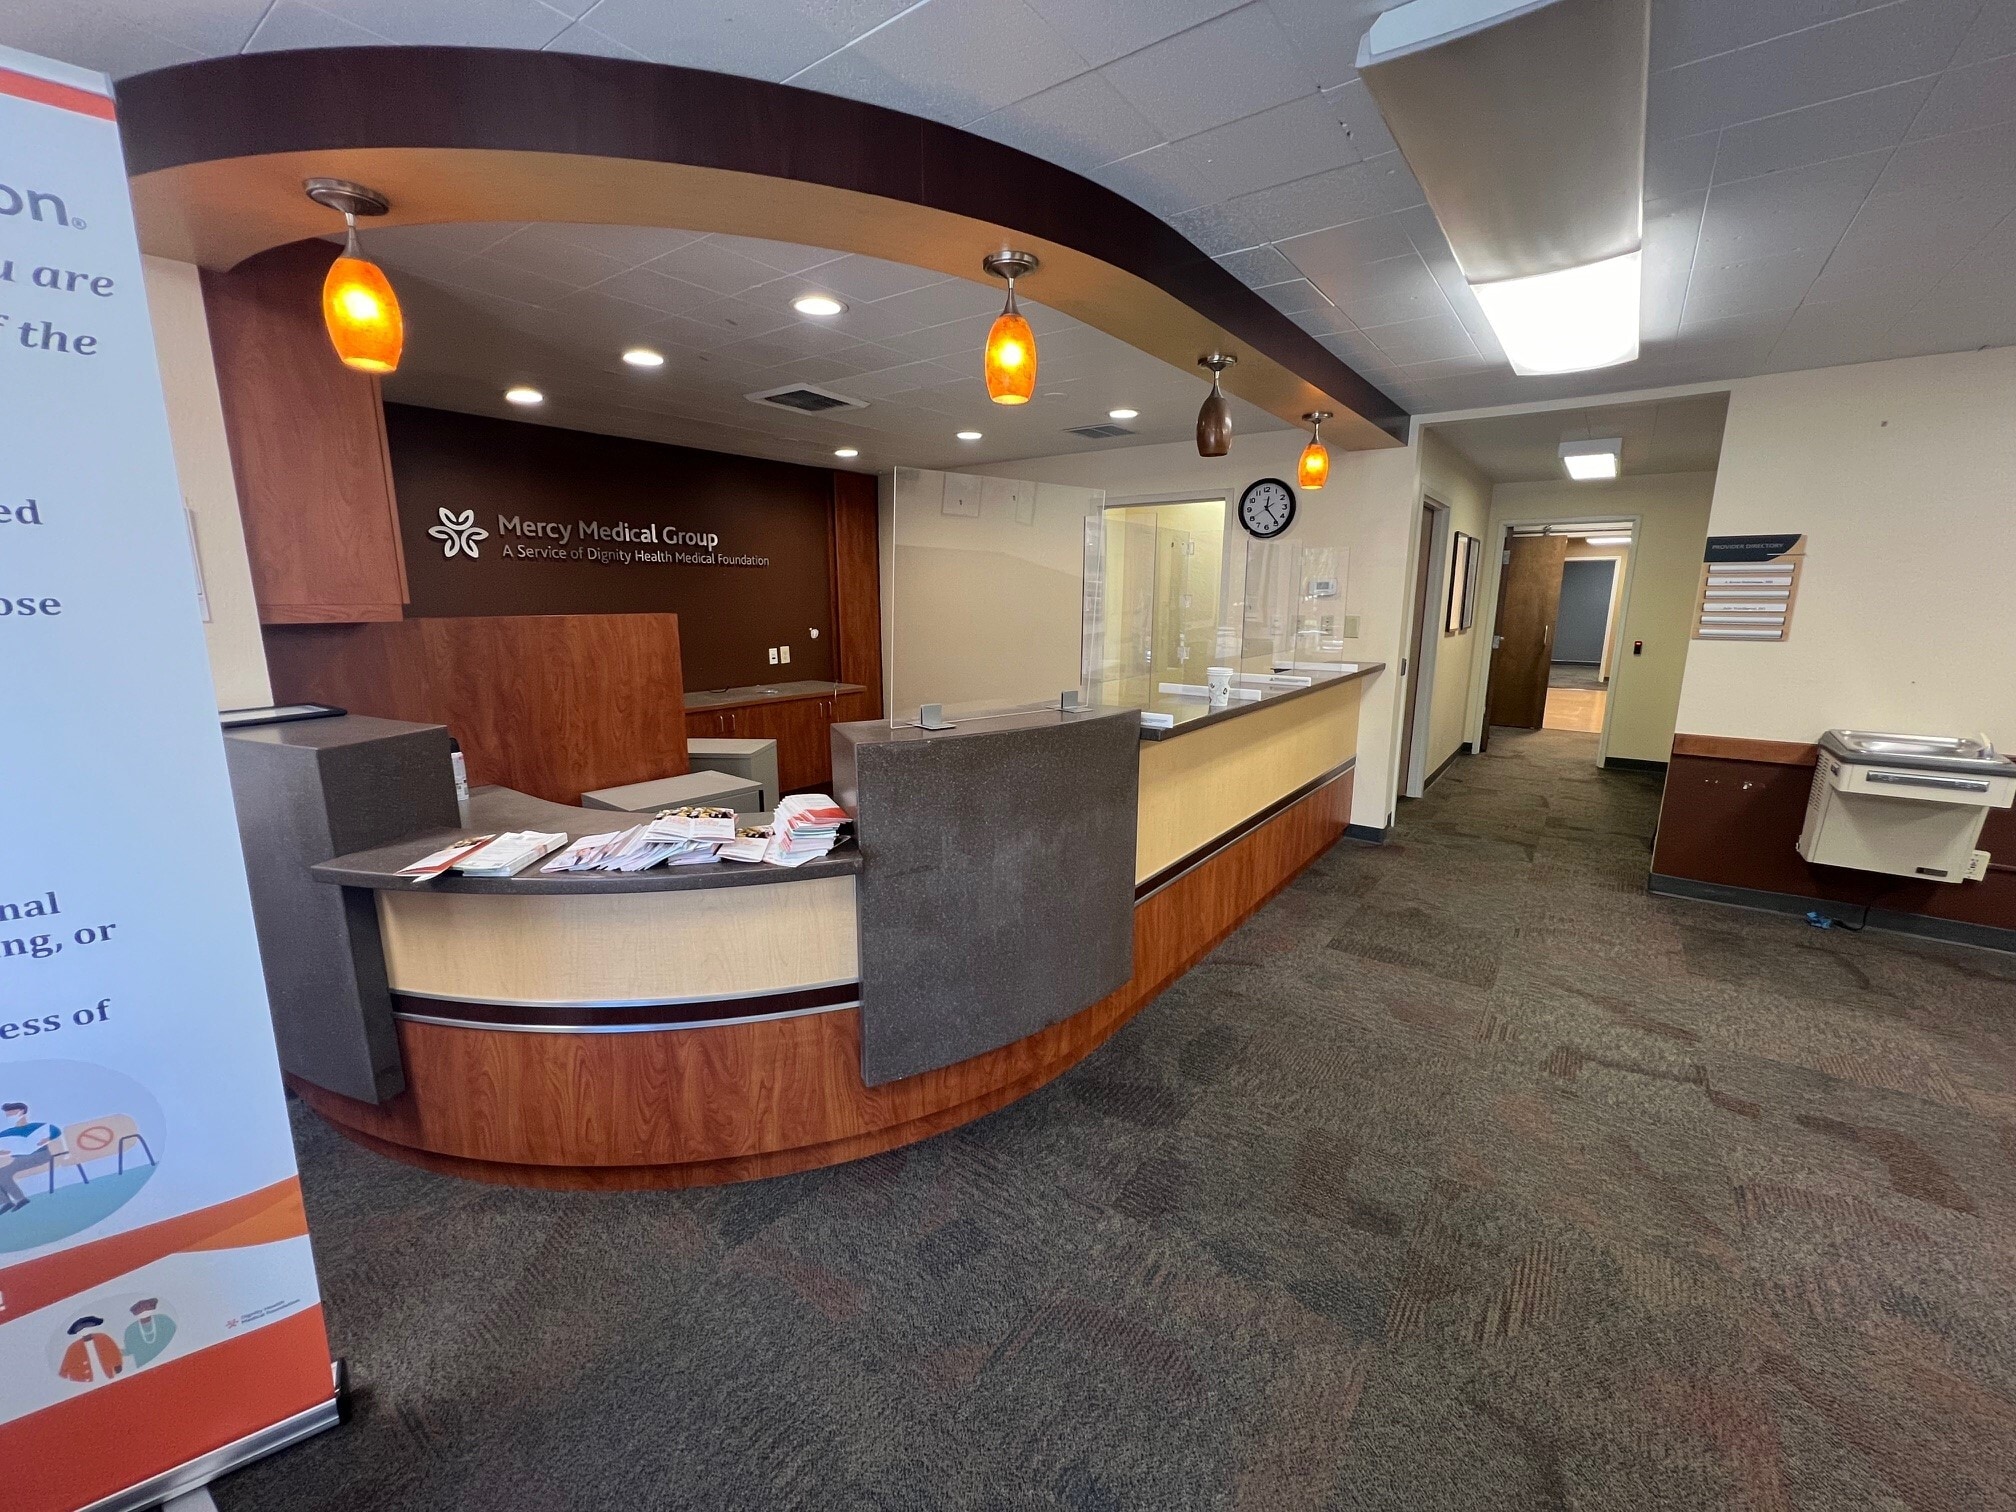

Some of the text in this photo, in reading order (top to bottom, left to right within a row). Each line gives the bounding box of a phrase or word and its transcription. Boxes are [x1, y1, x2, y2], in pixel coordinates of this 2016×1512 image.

[33, 266, 114, 297] are
[18, 320, 97, 355] the
[498, 514, 719, 552] Mercy Medical Group
[502, 544, 770, 566] A Service of Dignity Health Medical Foundation
[0, 891, 61, 921] nal
[0, 923, 116, 958] ng, or
[72, 998, 111, 1026] of
